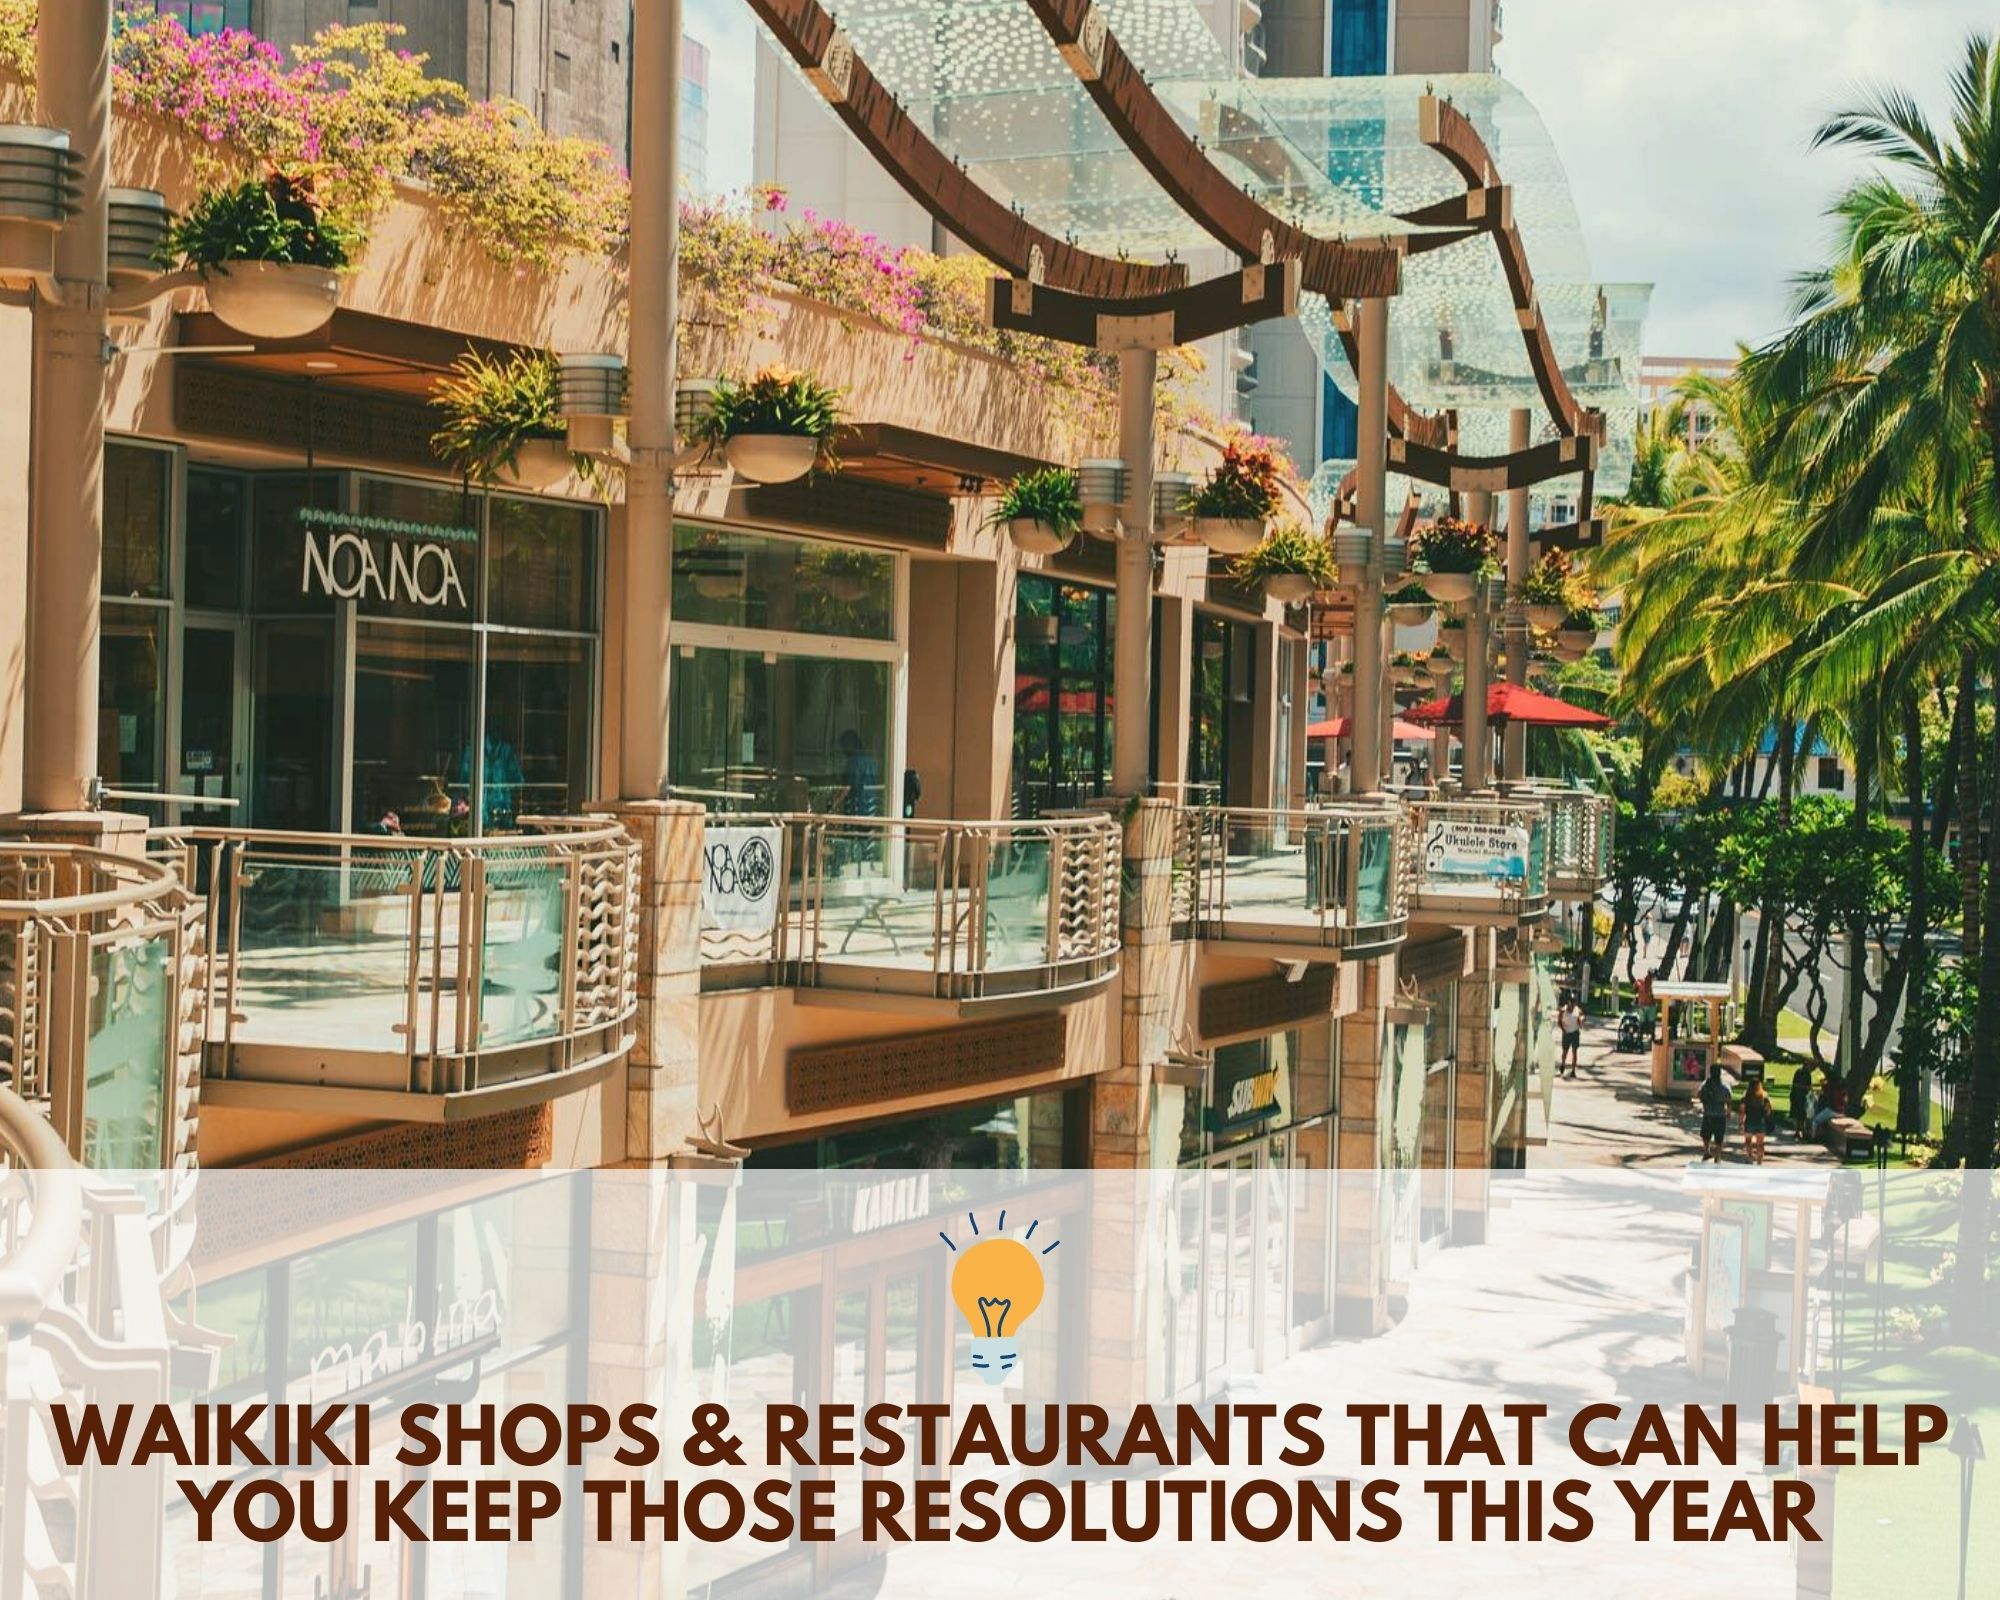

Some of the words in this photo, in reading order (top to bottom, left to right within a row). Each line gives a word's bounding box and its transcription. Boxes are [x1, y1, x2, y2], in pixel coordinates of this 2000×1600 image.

[302, 531, 387, 600] NOA
[389, 541, 467, 608] NOA
[1445, 834, 1485, 847] Ukulele
[1488, 837, 1517, 850] Store
[1227, 1067, 1280, 1119] SUBWAY
